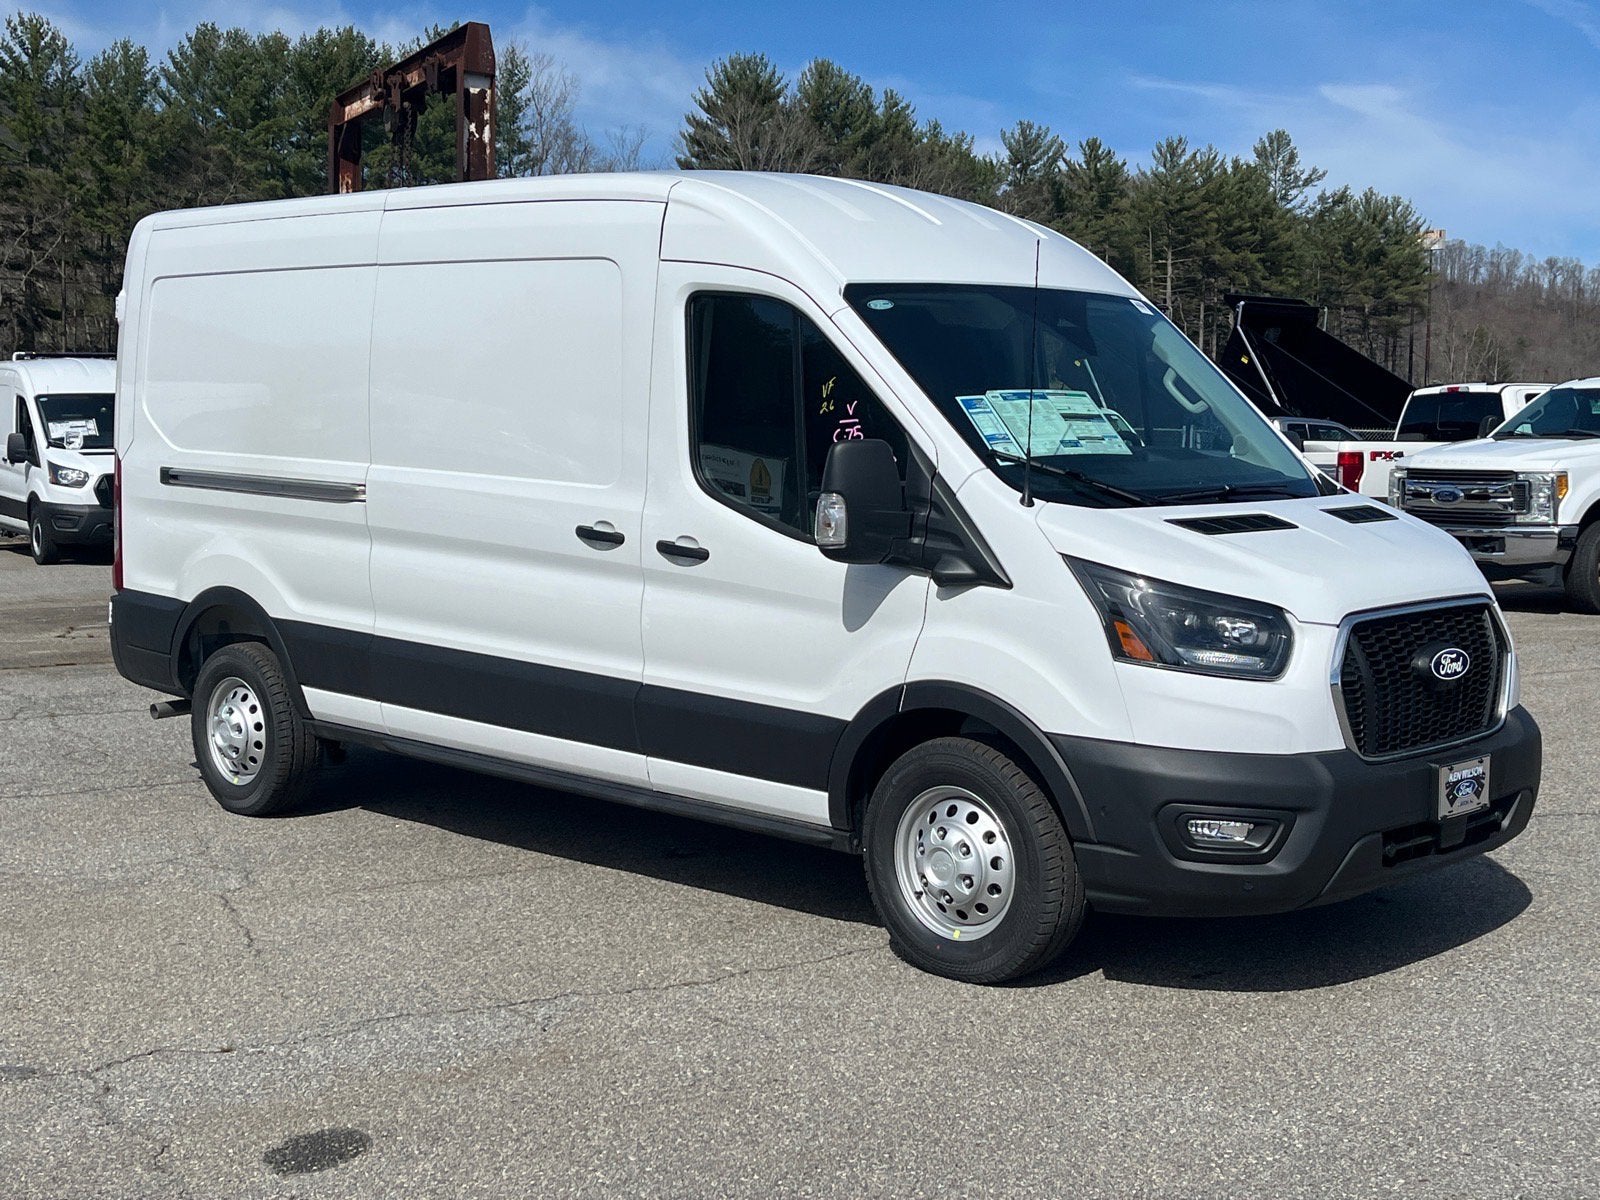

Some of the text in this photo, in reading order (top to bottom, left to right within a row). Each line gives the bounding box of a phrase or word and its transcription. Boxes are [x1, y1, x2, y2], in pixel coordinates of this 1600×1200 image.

[1370, 450, 1404, 462] FX4
[1440, 653, 1463, 675] Ford
[1458, 781, 1474, 796] Ford
